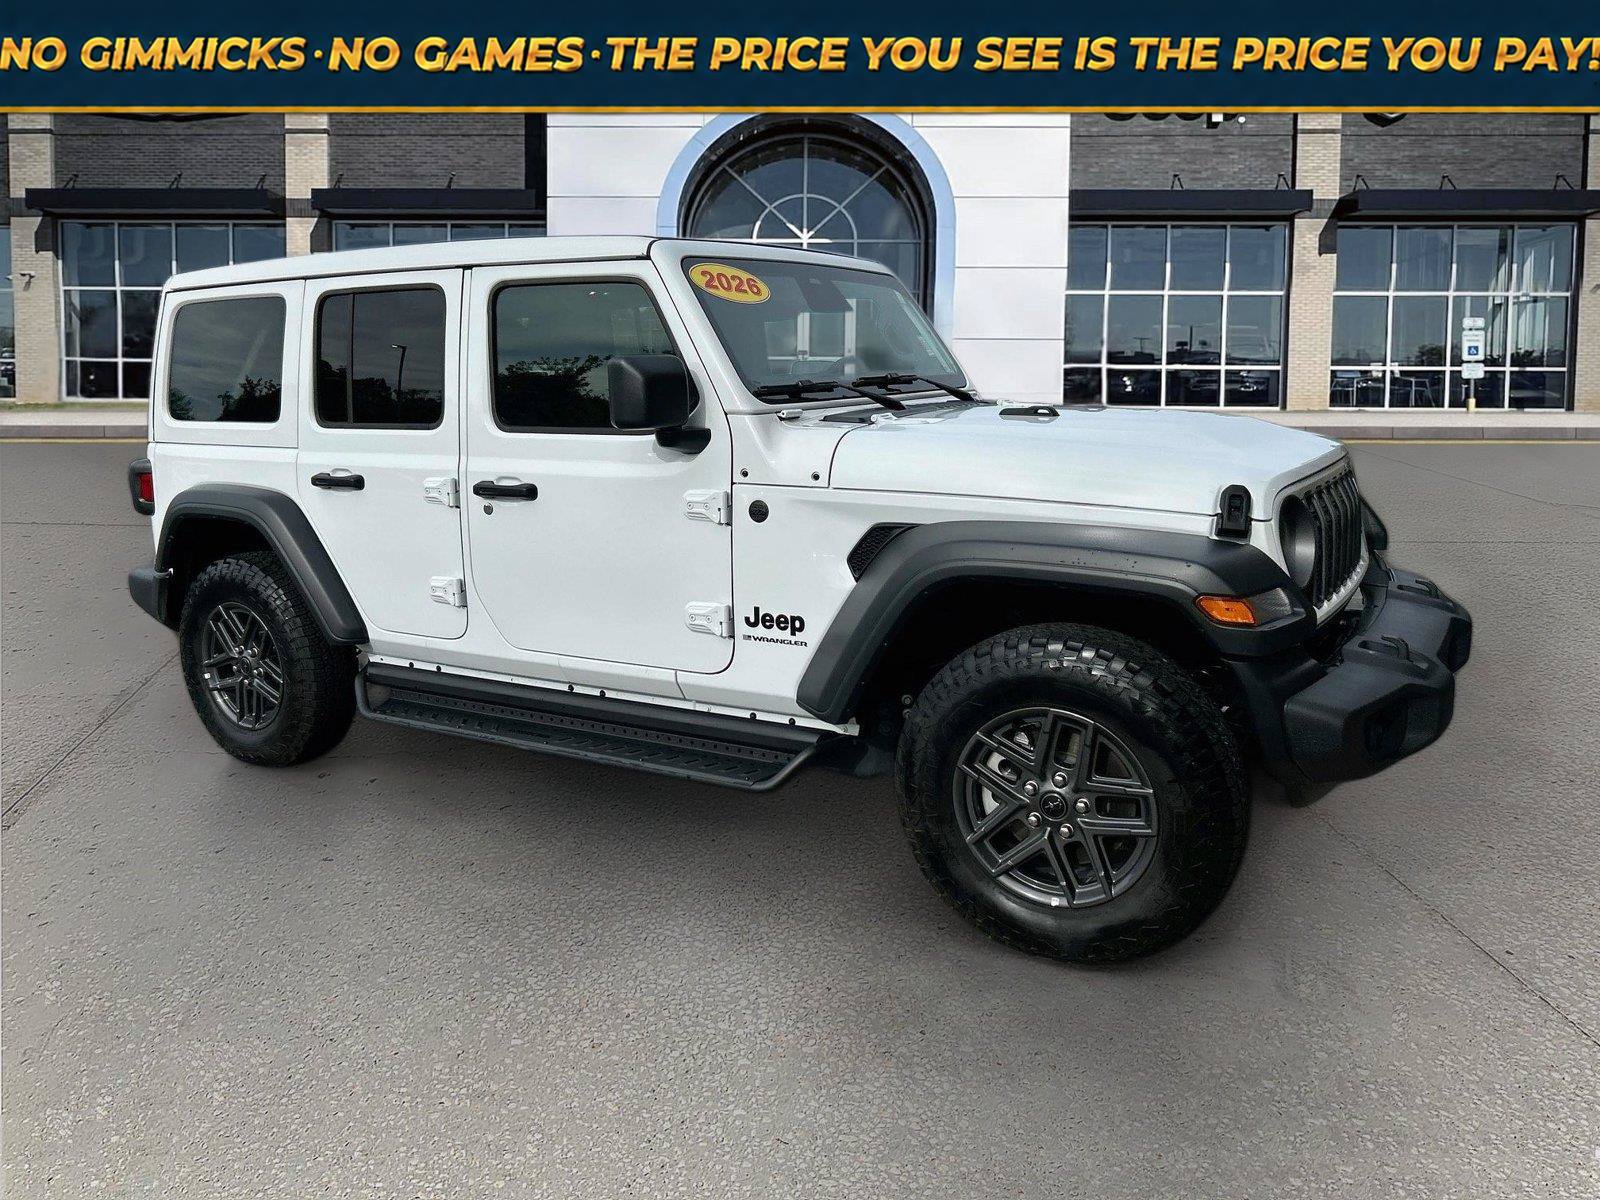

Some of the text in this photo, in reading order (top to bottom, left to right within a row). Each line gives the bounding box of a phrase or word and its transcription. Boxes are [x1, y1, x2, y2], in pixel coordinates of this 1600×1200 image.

[700, 270, 763, 296] 2026
[744, 606, 805, 637] Jeep
[752, 635, 808, 647] WRANGLER
